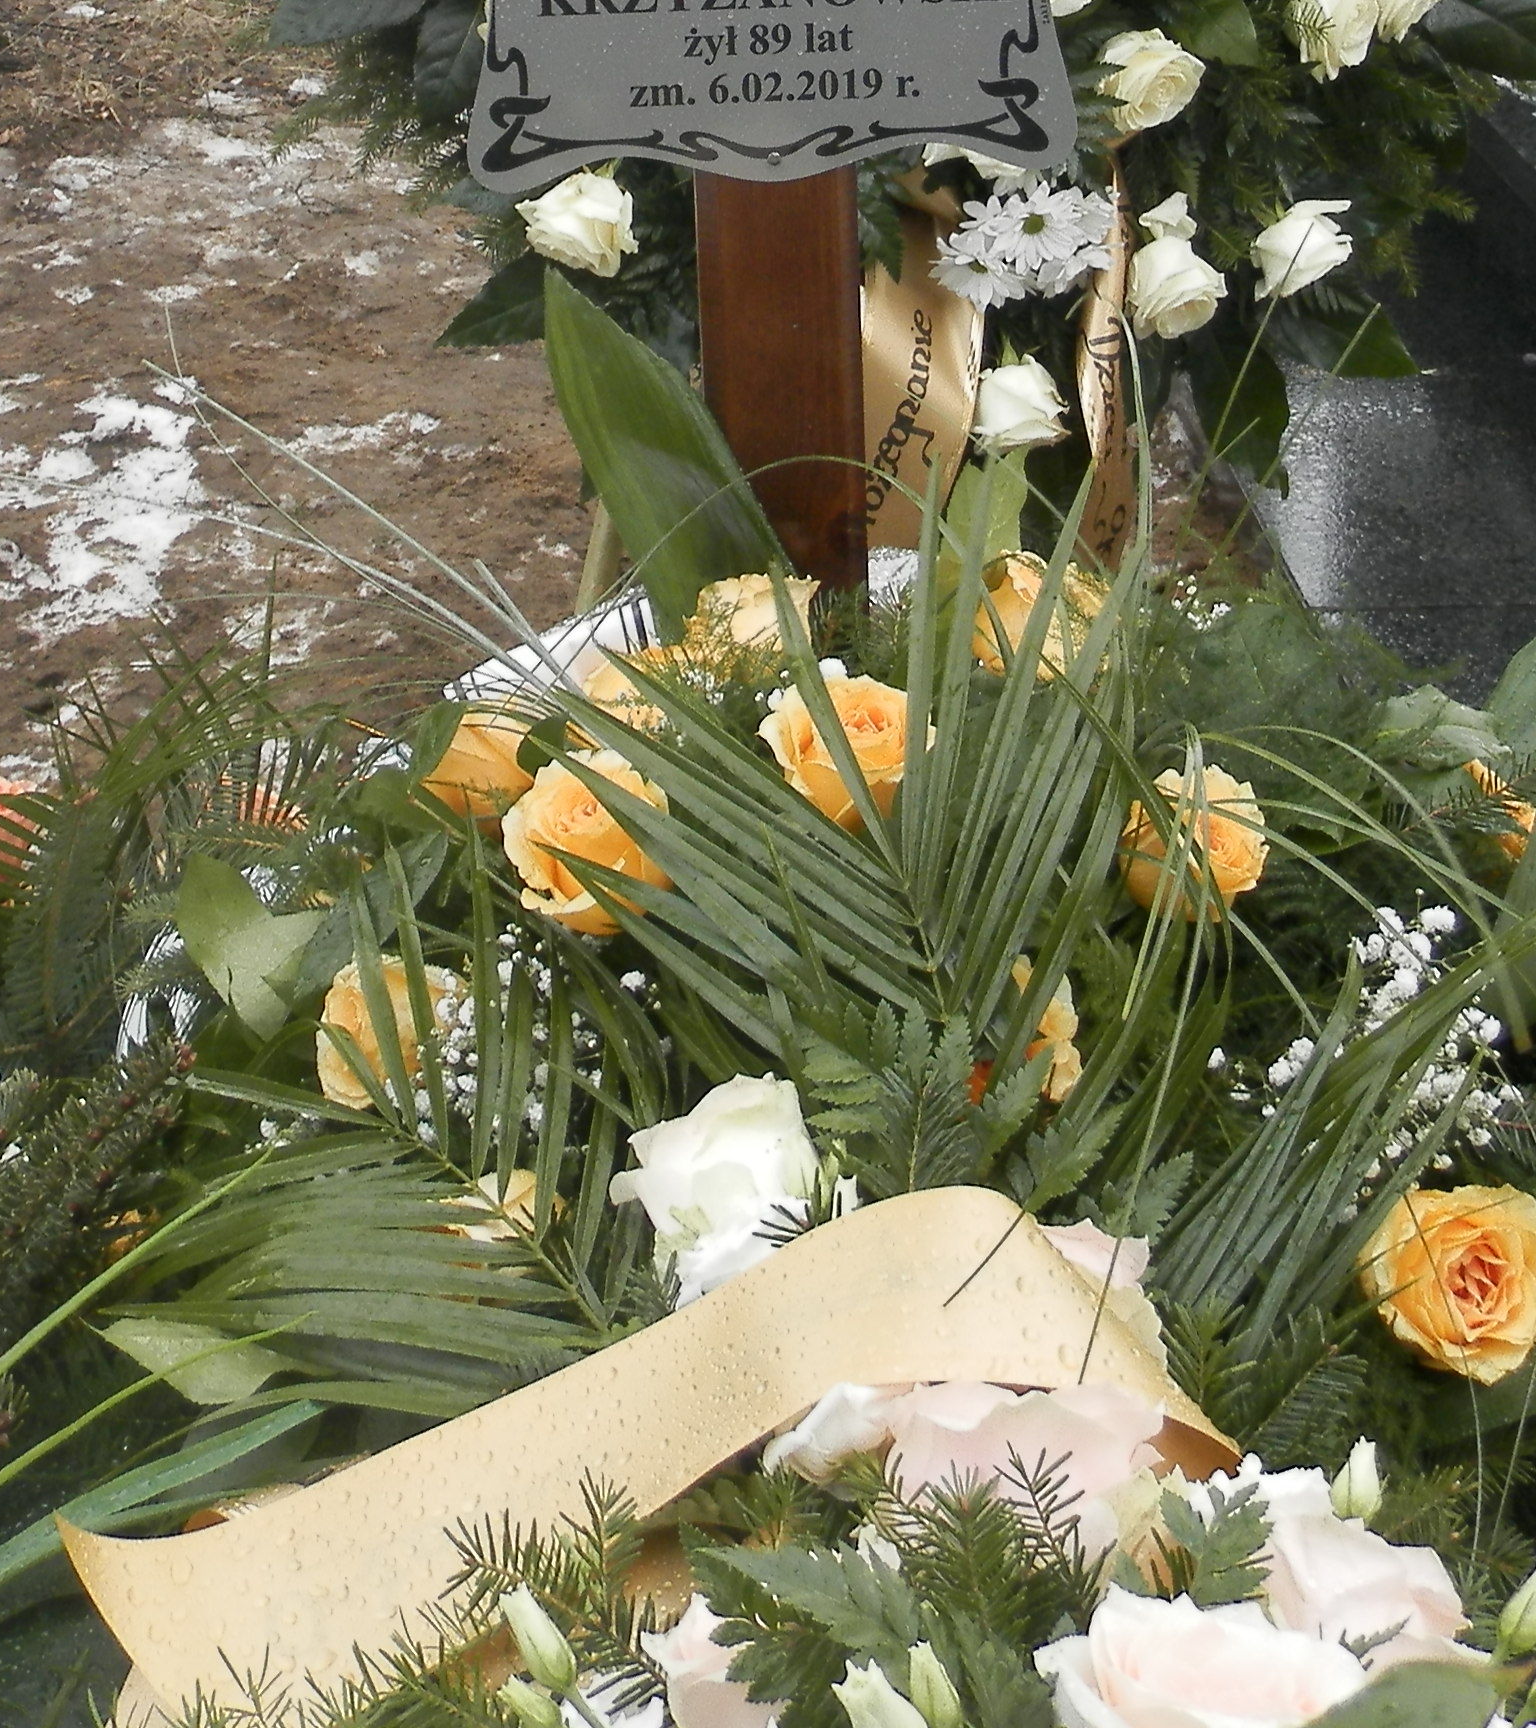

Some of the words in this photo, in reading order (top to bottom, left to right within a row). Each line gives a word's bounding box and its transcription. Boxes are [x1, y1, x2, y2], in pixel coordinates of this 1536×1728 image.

[683, 25, 740, 65] żył
[749, 26, 792, 56] 89
[803, 23, 855, 55] lat
[629, 79, 697, 109] zm.
[708, 70, 883, 106] 6.02.2019
[897, 75, 921, 99] r.
[865, 308, 935, 526] ożegnanie
